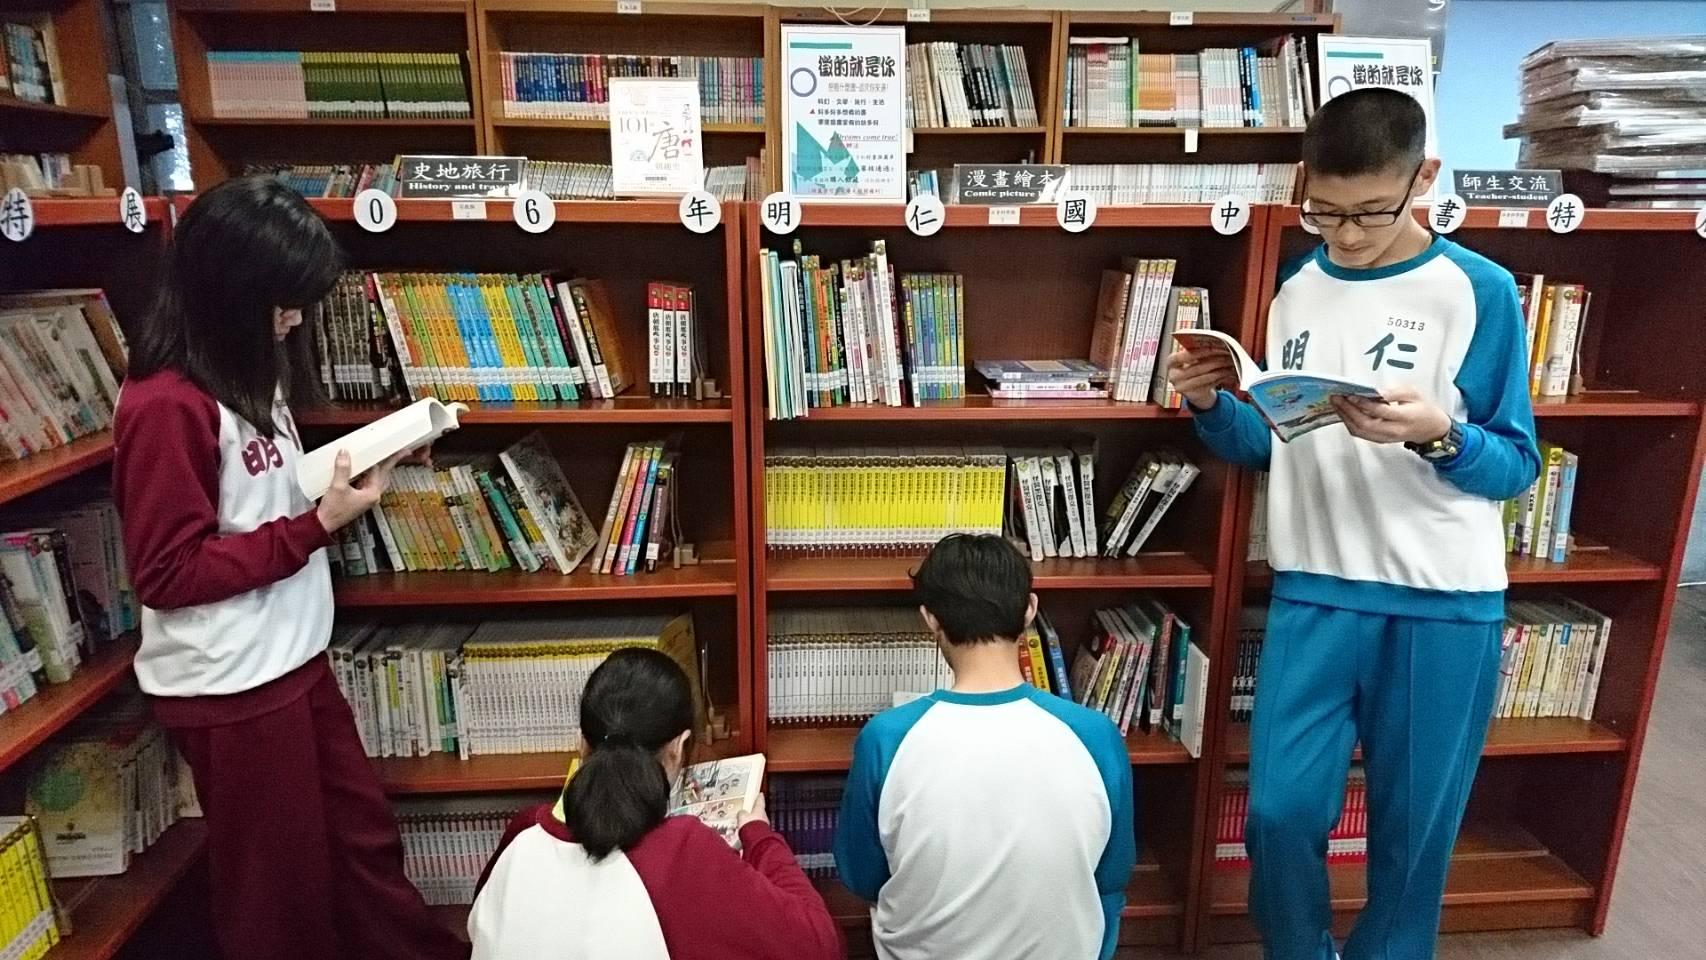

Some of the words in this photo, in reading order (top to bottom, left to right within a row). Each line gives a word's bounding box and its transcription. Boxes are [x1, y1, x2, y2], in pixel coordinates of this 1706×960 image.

[818, 55, 895, 77] 徵的就是你
[1353, 64, 1423, 86] 徵的就是你
[412, 162, 511, 181] 史地旅行
[967, 169, 1055, 188] 漫畫繪本
[408, 182, 451, 191] History
[454, 182, 475, 190] and
[1462, 173, 1551, 192] 師生交流
[964, 190, 997, 198] Comic
[999, 190, 1036, 199] picture
[1466, 192, 1549, 201] Teacher-student
[0, 192, 29, 236] 特
[126, 192, 148, 229] 展
[369, 198, 383, 224] 0
[525, 199, 540, 224] 6
[686, 196, 713, 226] 年
[767, 201, 790, 226] 明
[910, 205, 937, 231] 仁
[1064, 199, 1086, 224] 國
[1221, 201, 1240, 228] 中
[1436, 199, 1461, 228] 書
[1550, 202, 1576, 228] 特
[1387, 316, 1425, 331] 50313
[1282, 330, 1310, 370] 明
[1363, 333, 1418, 371] 仁
[241, 434, 284, 476] 明
